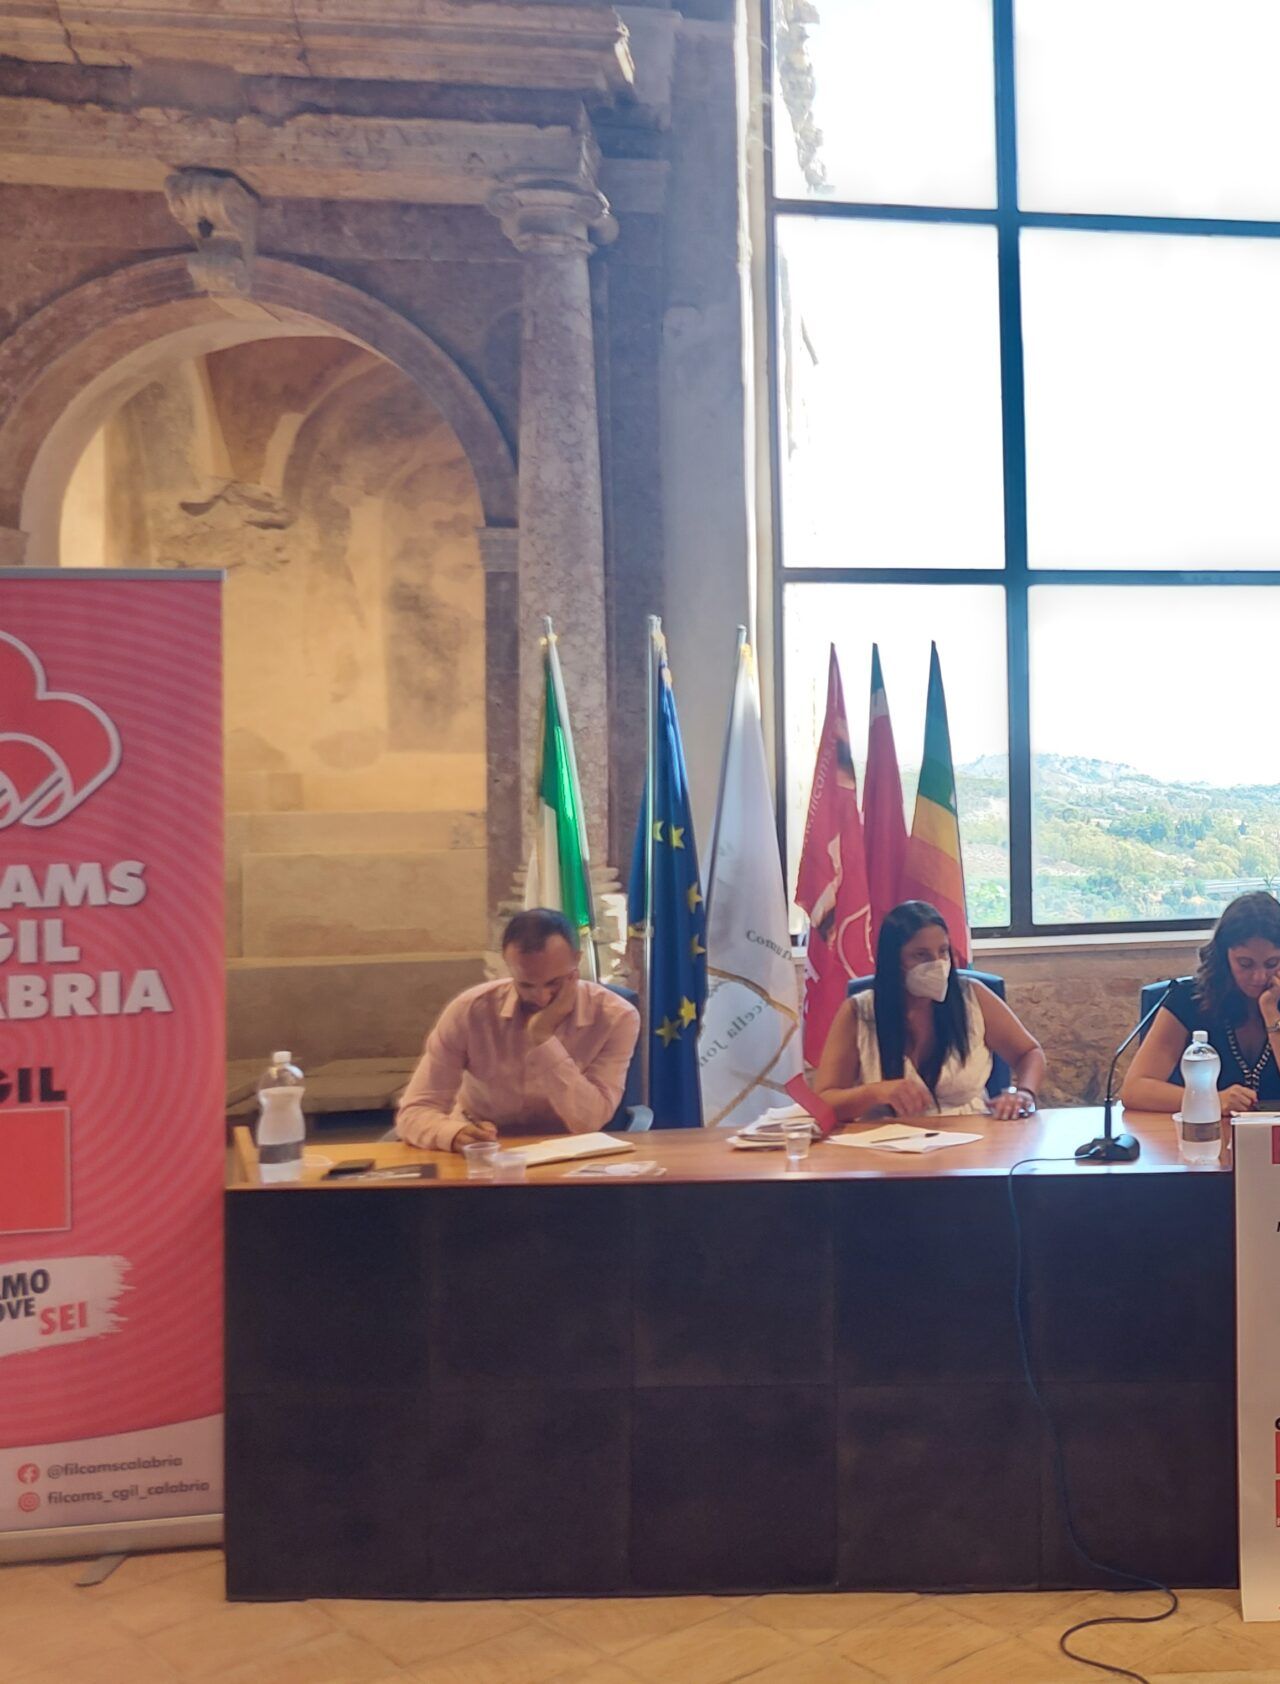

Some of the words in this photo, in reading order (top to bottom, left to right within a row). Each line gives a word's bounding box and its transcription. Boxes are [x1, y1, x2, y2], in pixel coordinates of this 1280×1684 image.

[0, 969, 174, 1019] BRIA
[0, 1269, 50, 1300] MO
[40, 1301, 88, 1336] SEI
[47, 1454, 184, 1480] @filcamscalabria
[47, 1479, 211, 1505] filcams_cgil_calabria
